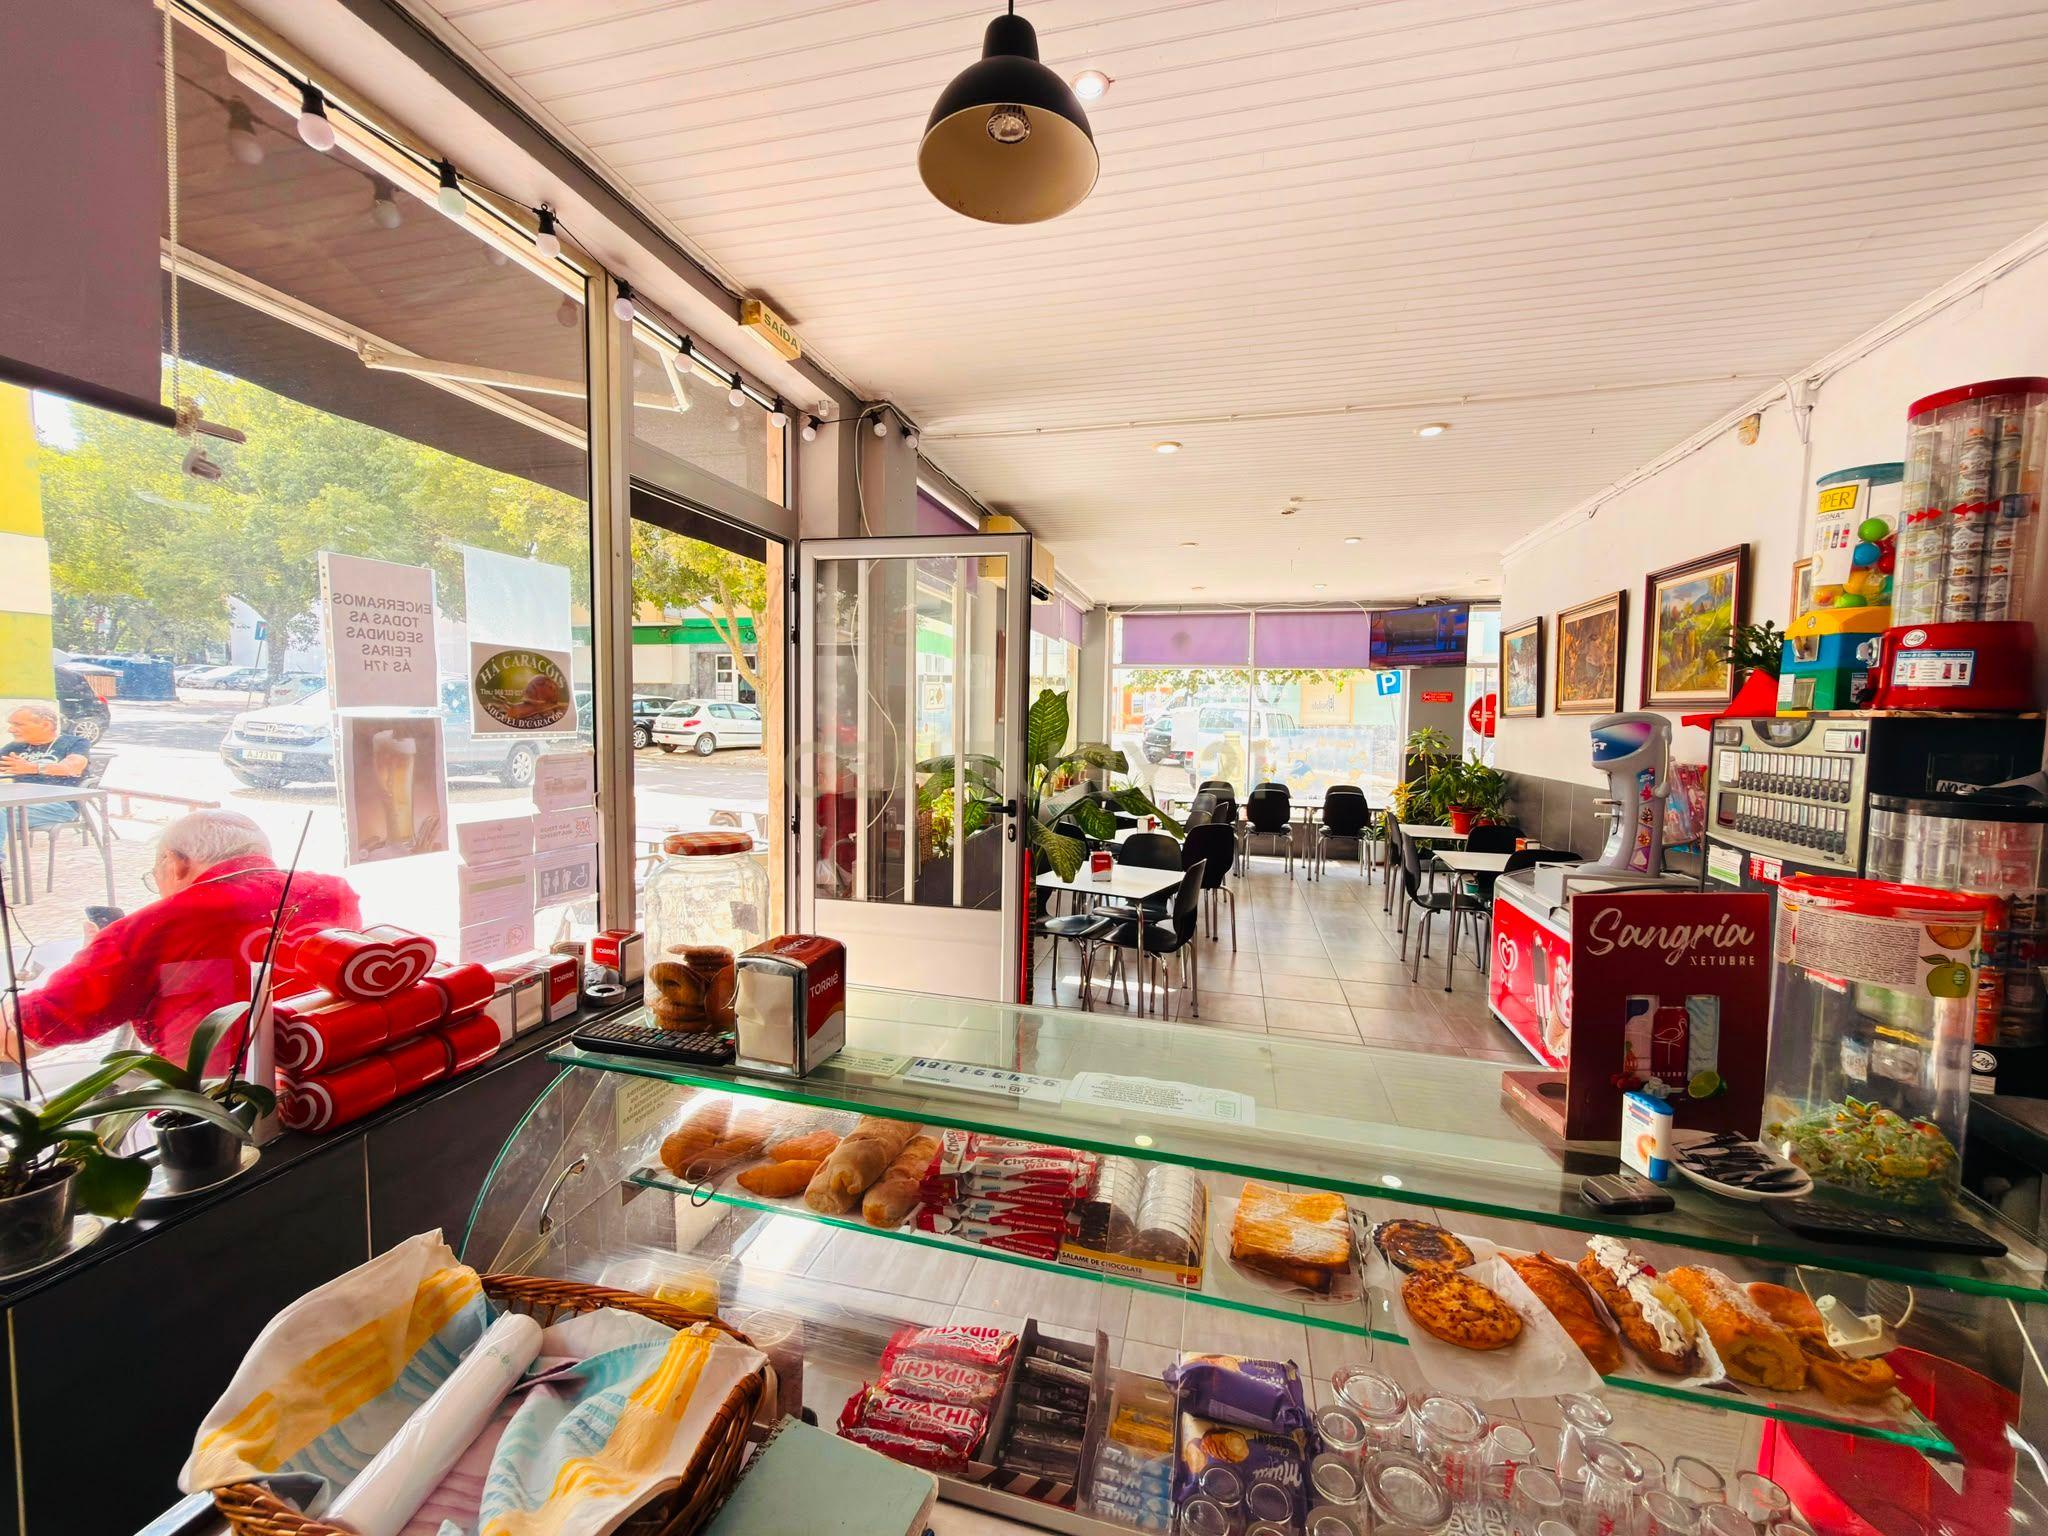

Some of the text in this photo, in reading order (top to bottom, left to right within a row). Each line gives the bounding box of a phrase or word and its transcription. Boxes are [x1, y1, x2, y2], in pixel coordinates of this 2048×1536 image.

[764, 313, 798, 350] SAÍDA
[1382, 672, 1397, 692] P
[1003, 1156, 1045, 1167] Choco
[1062, 1252, 1089, 1263] SALAME
[1101, 1260, 1143, 1274] CHOCOLATE
